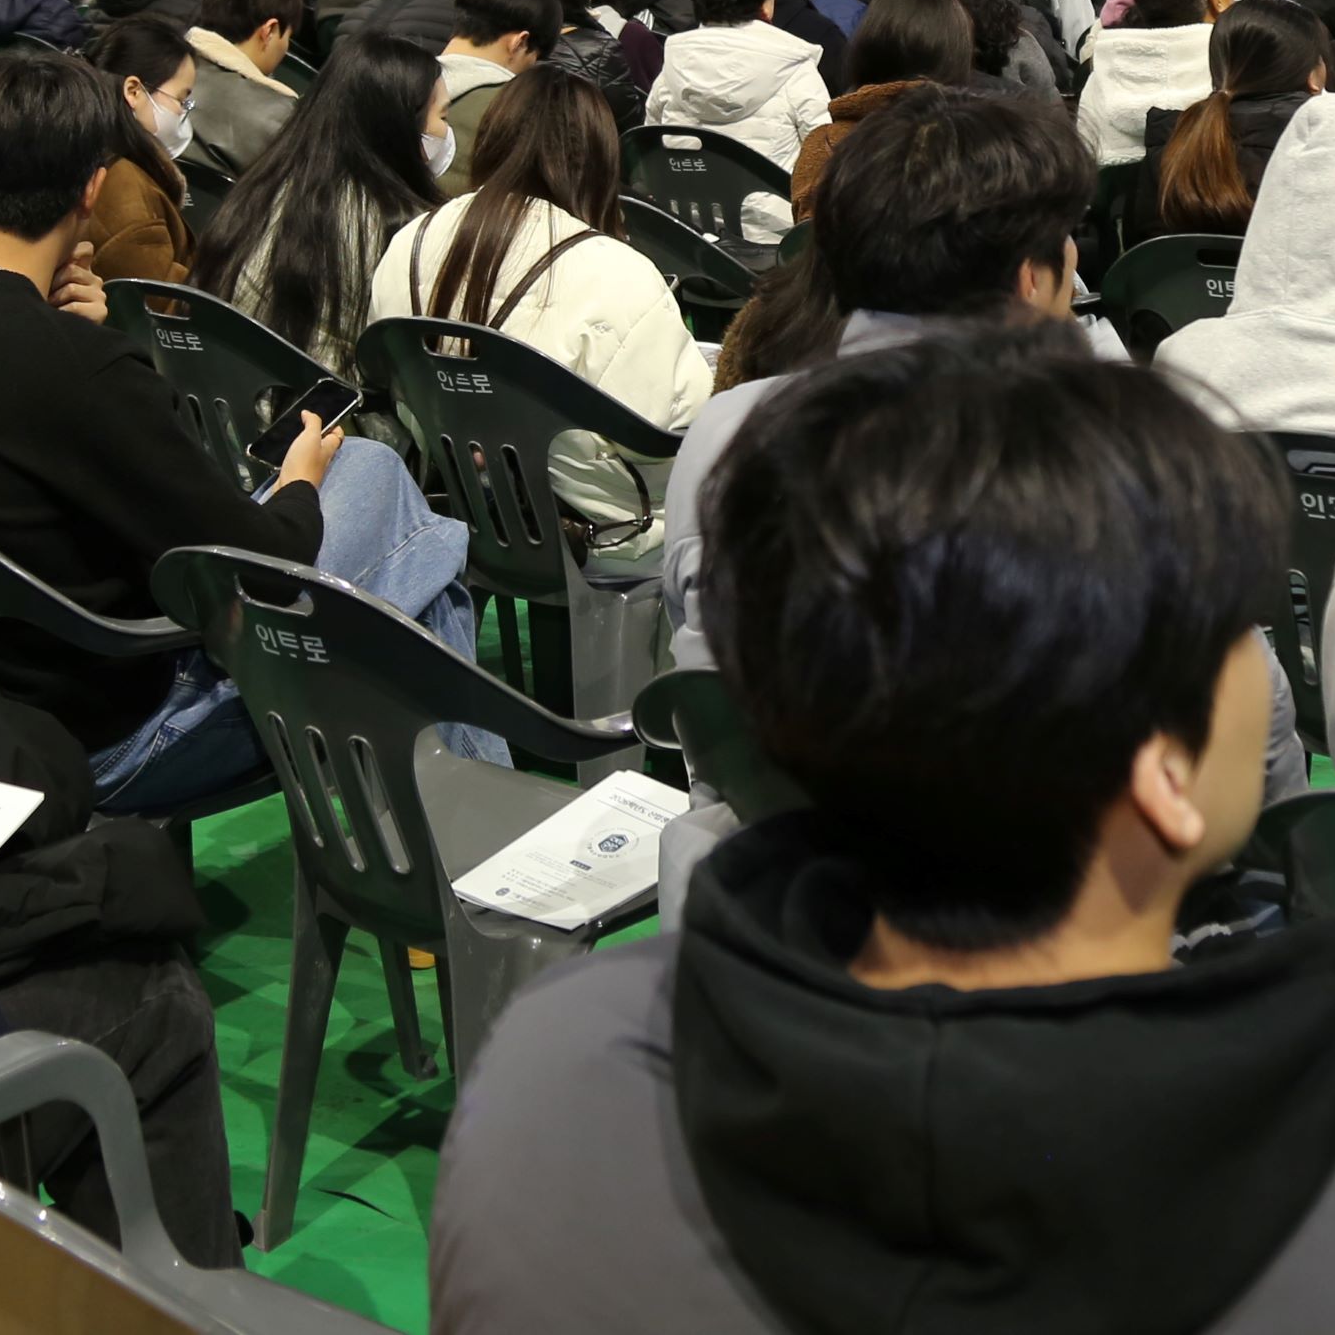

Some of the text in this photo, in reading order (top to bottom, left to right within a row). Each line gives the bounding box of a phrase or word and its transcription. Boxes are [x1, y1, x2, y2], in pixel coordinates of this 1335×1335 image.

[669, 157, 707, 172] 인트로
[156, 328, 204, 351] 인트로
[436, 370, 493, 394] 인트로
[255, 623, 330, 663] 인트로
